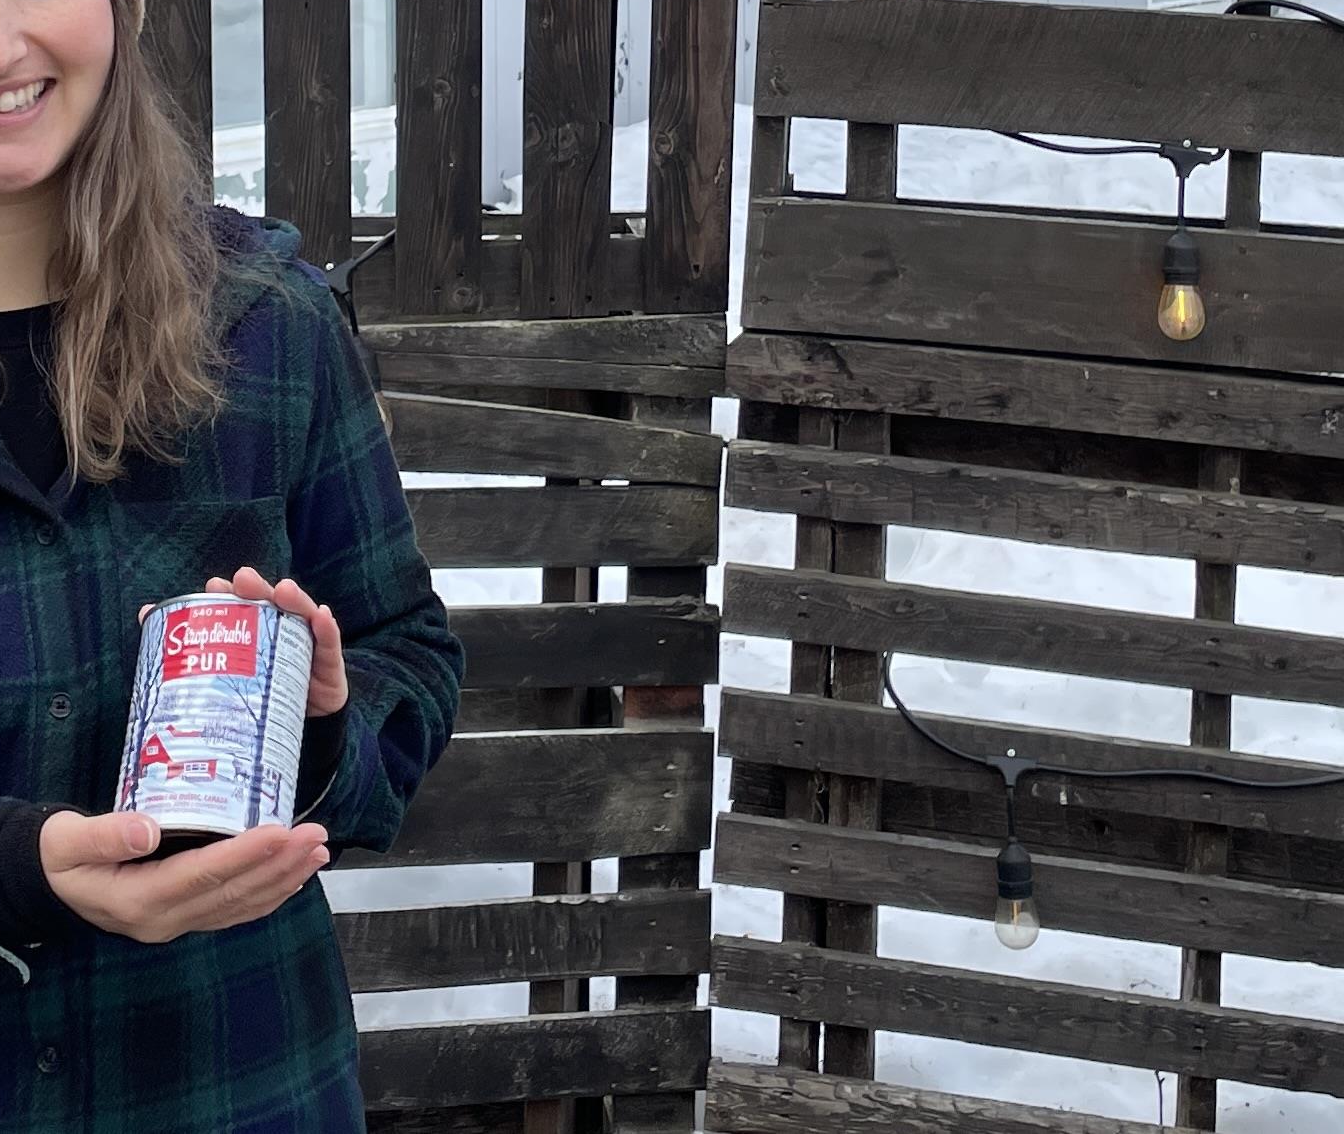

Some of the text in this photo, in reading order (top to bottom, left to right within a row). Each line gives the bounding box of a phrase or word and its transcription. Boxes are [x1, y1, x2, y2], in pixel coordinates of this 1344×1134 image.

[192, 607, 229, 618] 540 ml
[167, 621, 209, 655] Sirop
[186, 652, 228, 673] PUR
